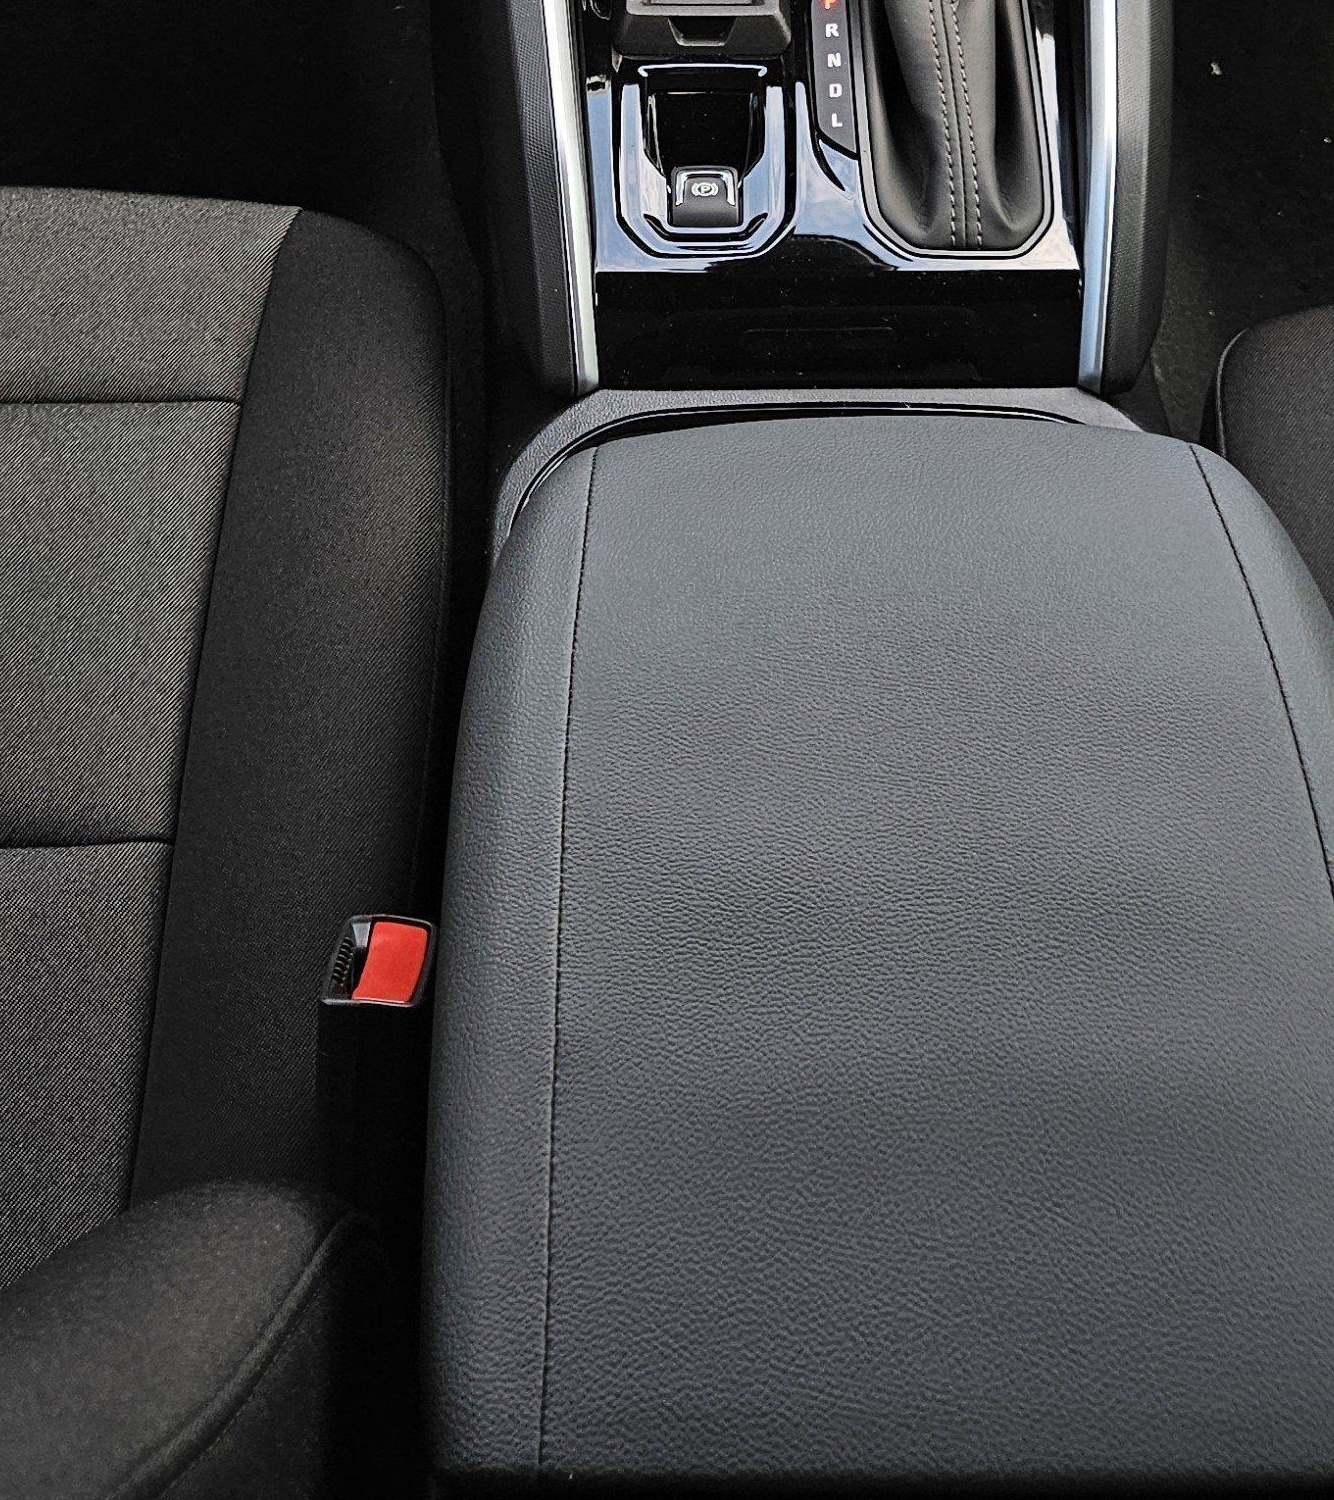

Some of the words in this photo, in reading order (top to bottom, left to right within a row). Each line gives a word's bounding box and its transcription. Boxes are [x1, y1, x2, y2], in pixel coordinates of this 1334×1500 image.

[825, 23, 840, 38] R
[827, 53, 842, 68] N
[829, 83, 843, 98] D
[831, 113, 843, 128] L
